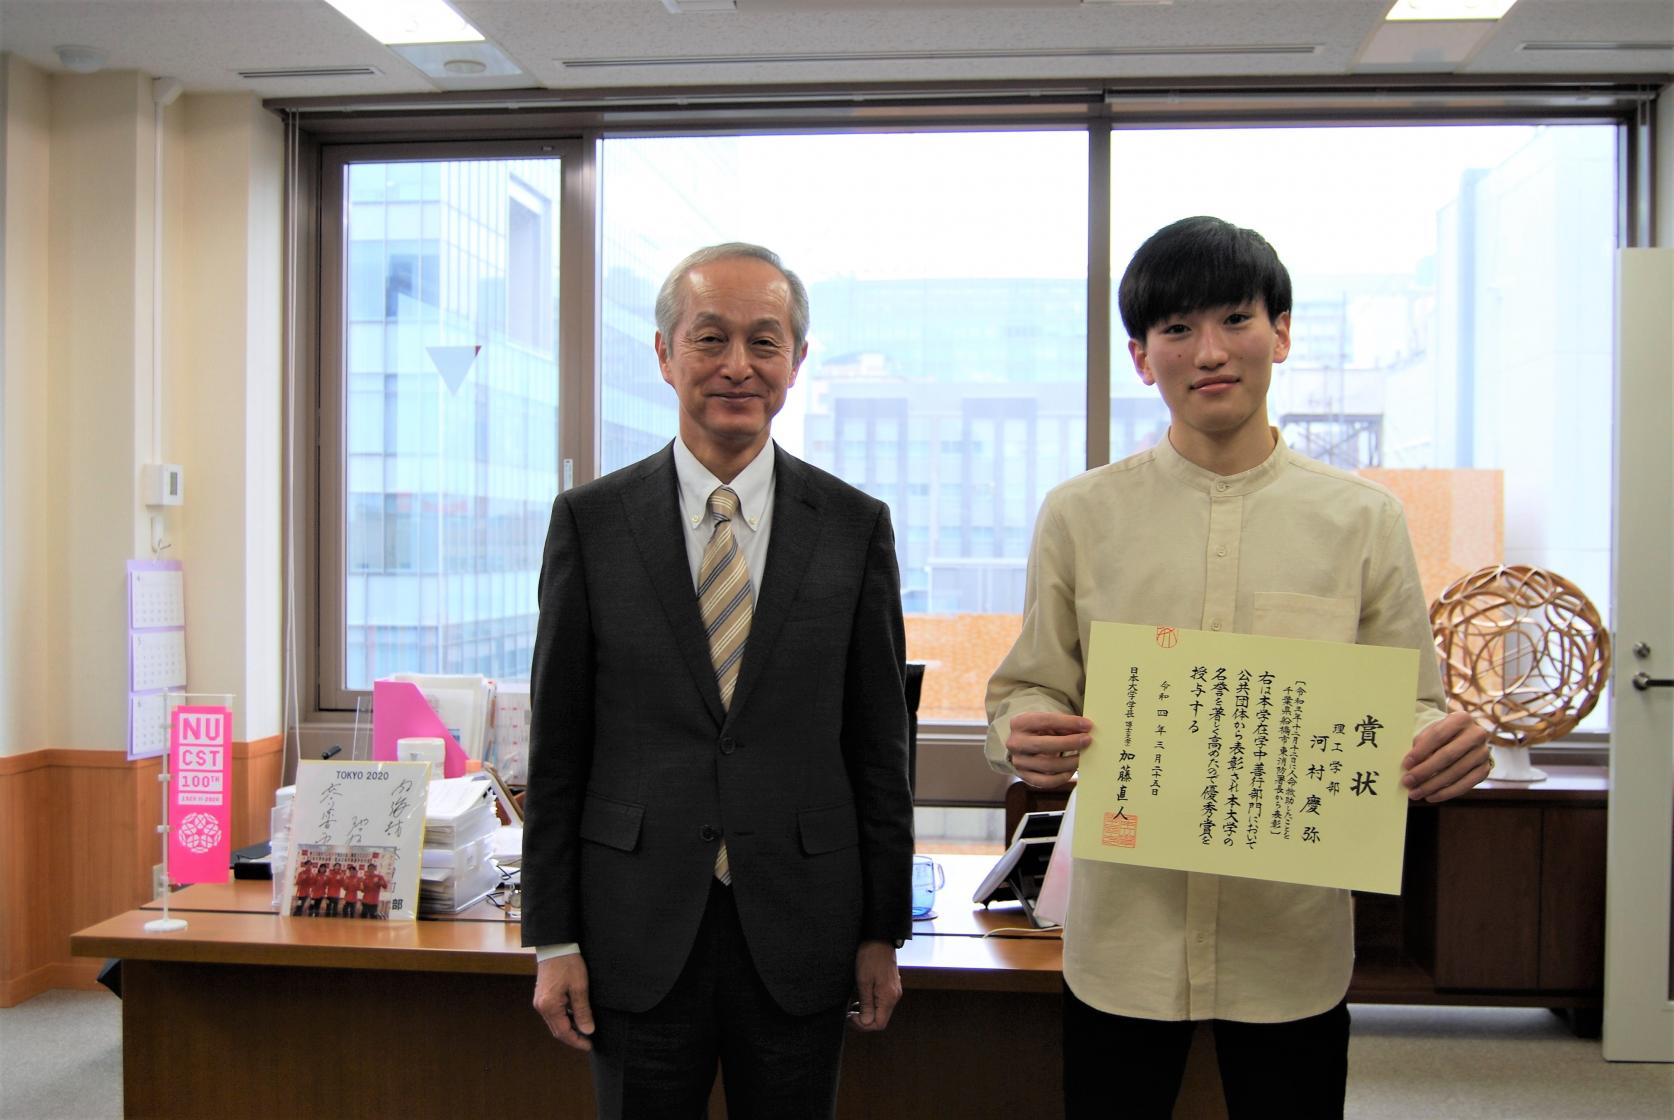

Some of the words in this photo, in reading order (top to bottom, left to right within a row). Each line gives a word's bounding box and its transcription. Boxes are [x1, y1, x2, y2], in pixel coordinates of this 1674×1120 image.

[183, 717, 221, 741] NU
[1124, 666, 1140, 718] 日本大学学長
[1188, 665, 1208, 734] 授与する
[182, 749, 221, 767] CST
[336, 770, 363, 781] TOKYO
[366, 771, 389, 781] 2020
[1150, 680, 1171, 797] 令和四年三月二十五日
[1199, 667, 1230, 846] 名誉を著しく高めたので優秀賞を
[1223, 668, 1253, 847] 公共団体から表彰され本大学の
[1246, 670, 1276, 850] 右は本学在学中善行部門において
[1326, 723, 1346, 797] 理工学部
[1350, 714, 1385, 797] 賞状
[1113, 749, 1136, 821] 加藤直人
[1300, 734, 1330, 844] 河村慶弥
